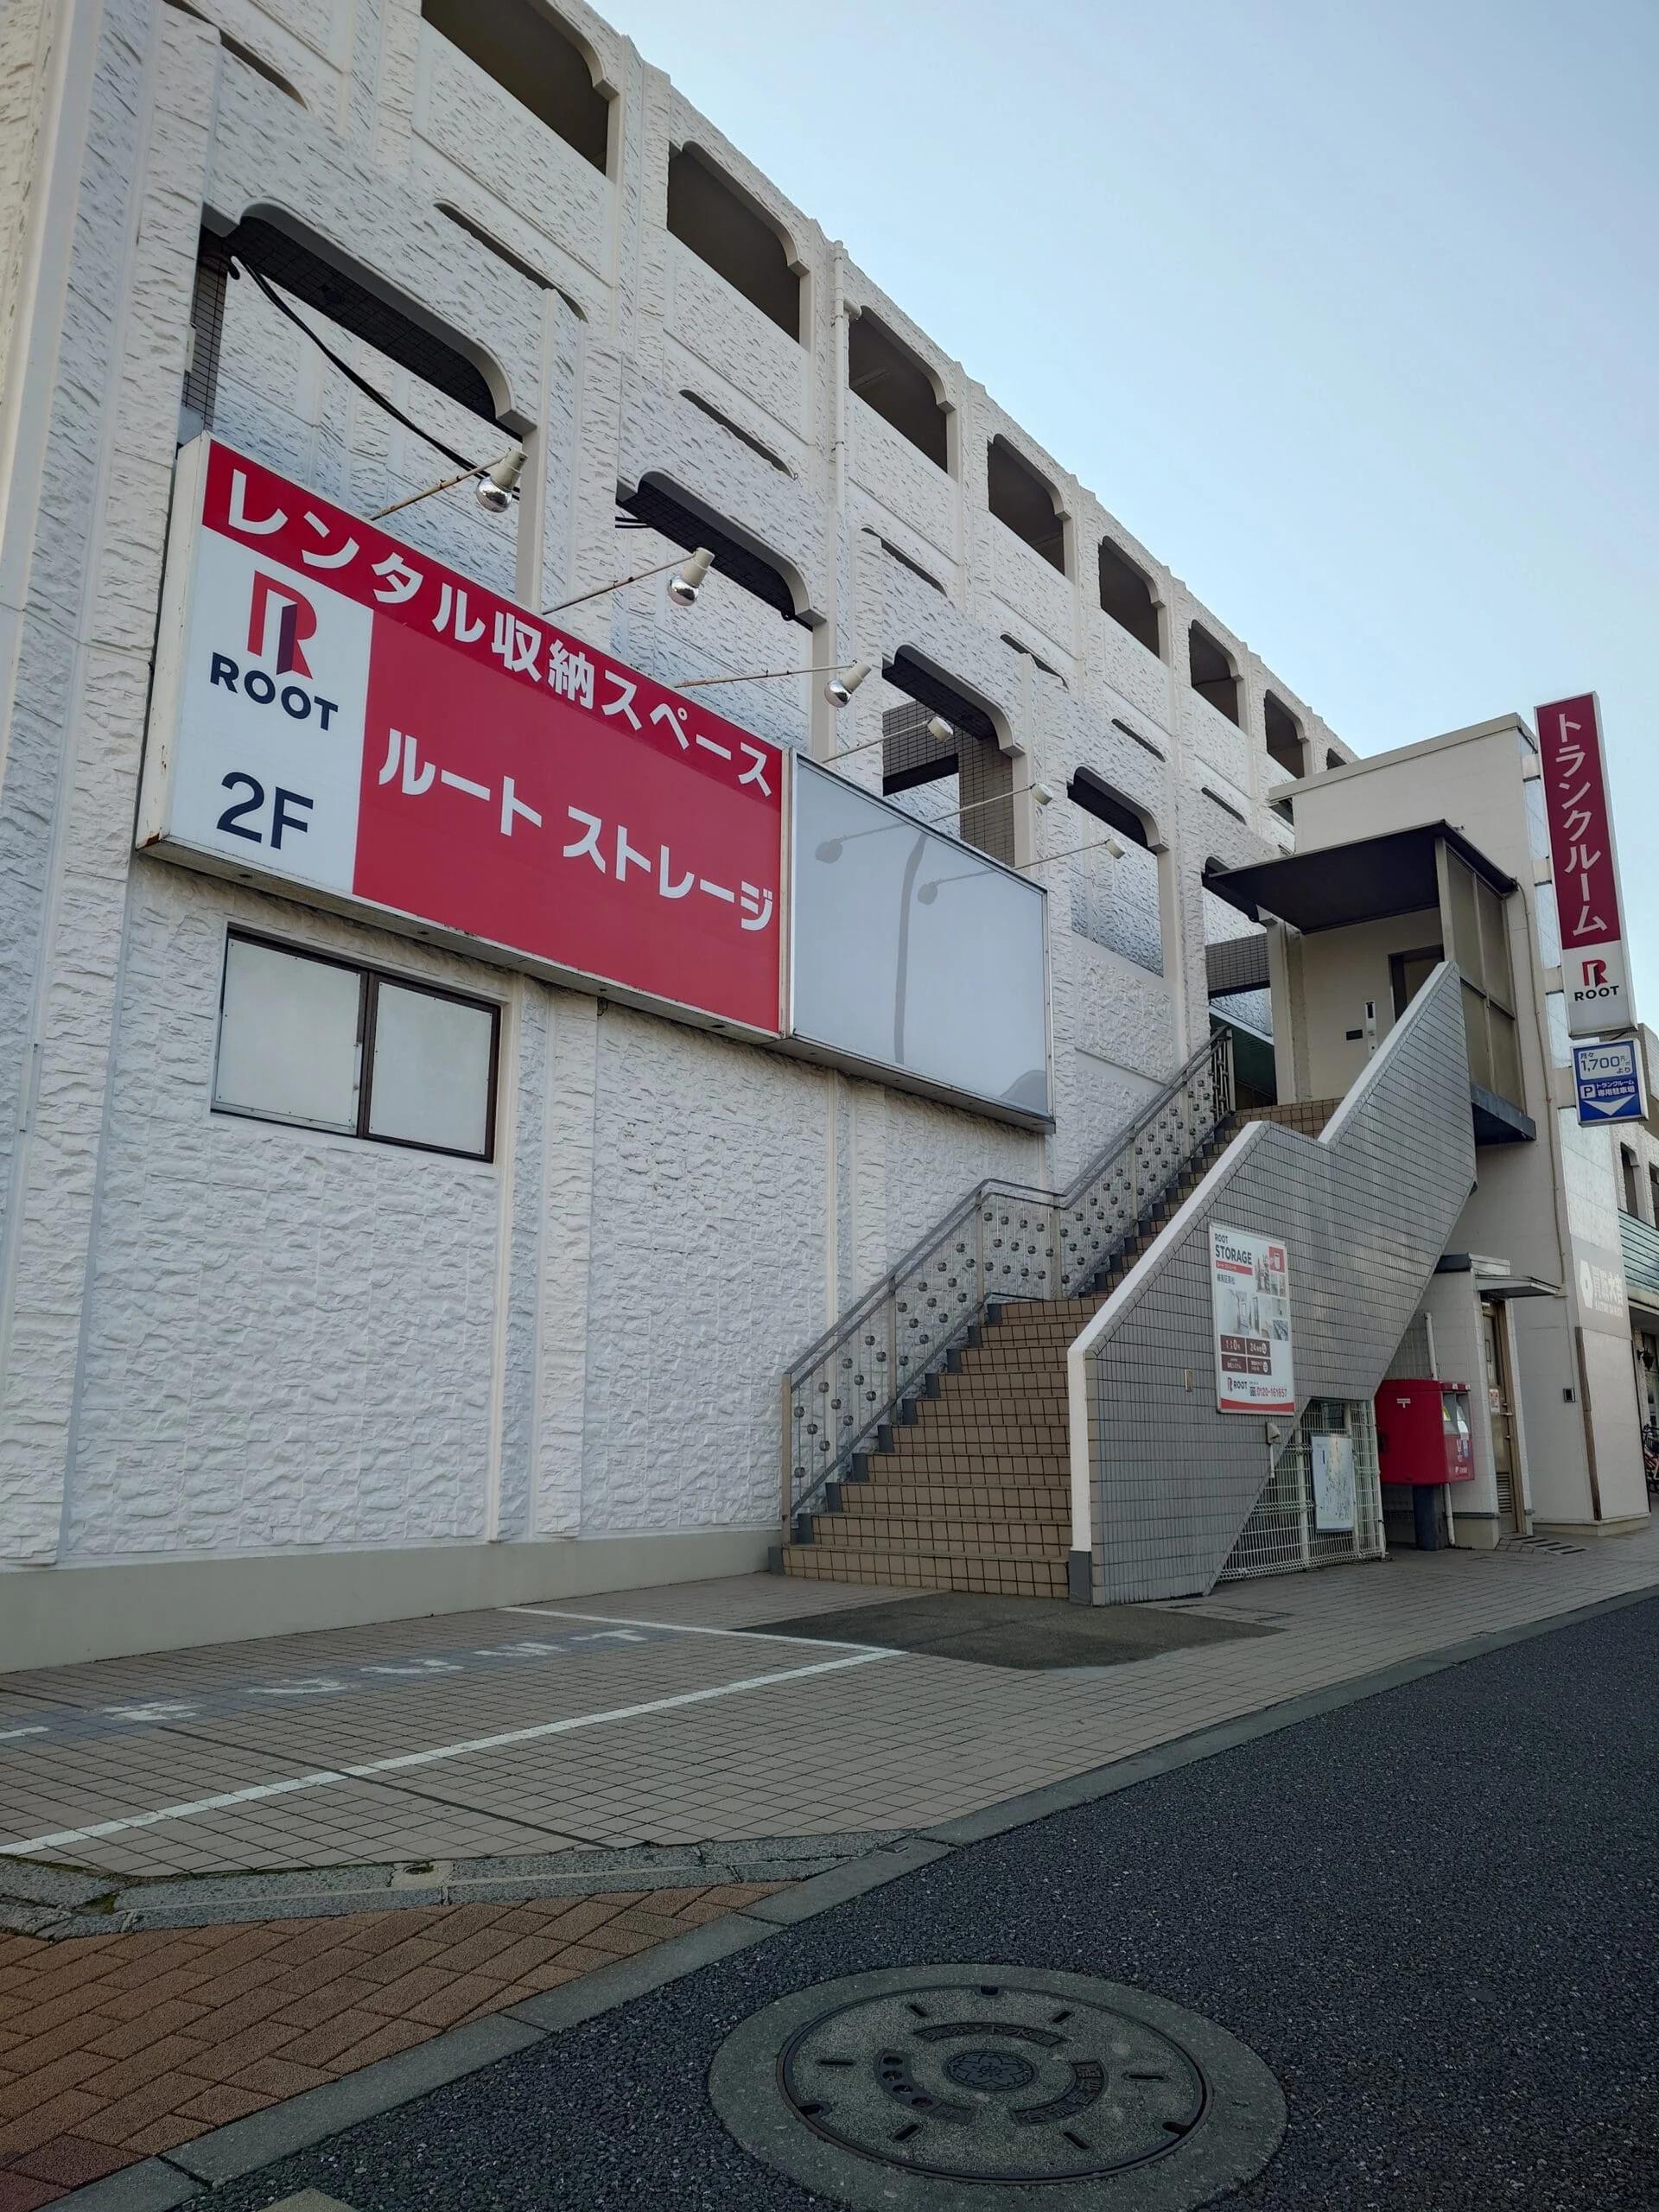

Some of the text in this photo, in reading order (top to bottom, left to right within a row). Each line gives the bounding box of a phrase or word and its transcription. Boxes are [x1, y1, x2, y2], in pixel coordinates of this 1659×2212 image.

[227, 467, 772, 798] レンタル収納スペース
[209, 652, 339, 732] ROOT
[216, 771, 315, 850] 2F
[378, 728, 773, 932] ルート ストレージ
[1556, 712, 1608, 937] トランクルーム
[1574, 985, 1619, 1001] ROOT
[1583, 1086, 1593, 1097] P
[1596, 1079, 1635, 1089] トランクルーム
[1215, 1233, 1228, 1244] ROOT
[1215, 1244, 1253, 1265] STORAGE
[1233, 1381, 1248, 1390] ROOT
